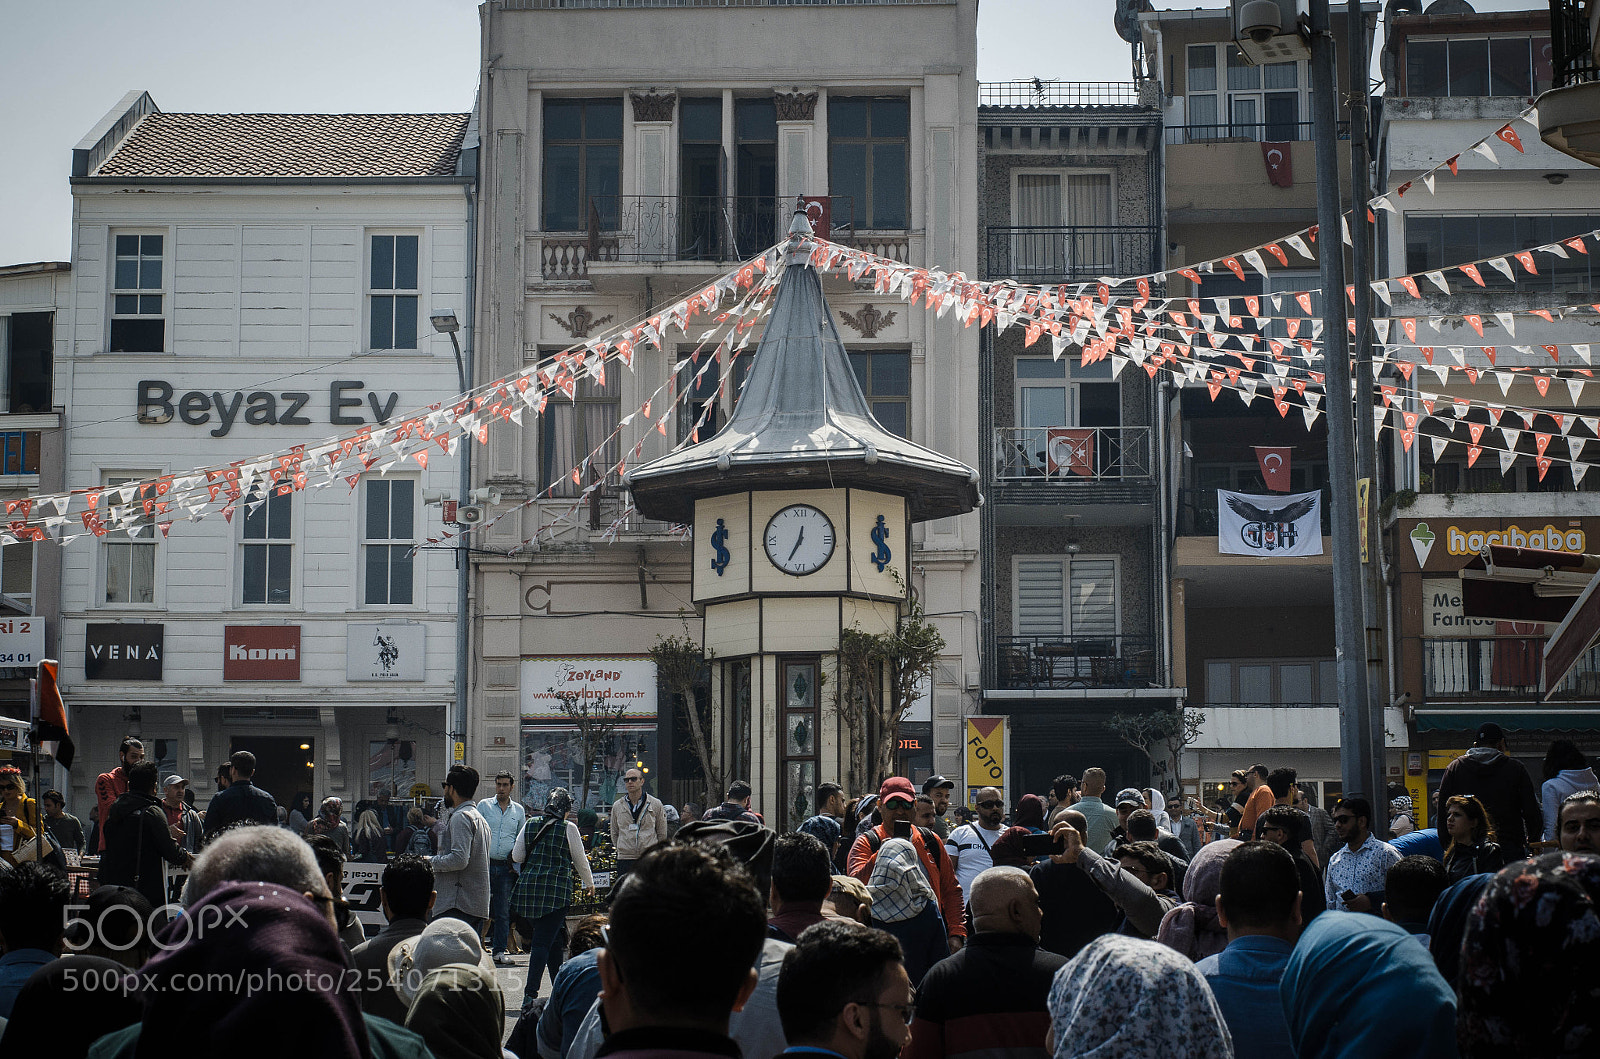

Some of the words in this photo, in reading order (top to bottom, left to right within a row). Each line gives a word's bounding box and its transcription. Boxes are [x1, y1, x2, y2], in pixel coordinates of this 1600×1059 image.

[137, 380, 311, 437] Beyaz
[330, 380, 399, 425] Ev
[1433, 593, 1463, 607] Me
[20, 622, 31, 634] 2
[18, 653, 31, 662] 01
[90, 644, 159, 660] VENA
[229, 644, 296, 660] Kom
[968, 736, 1003, 779] FOTO
[352, 871, 379, 880] Local
